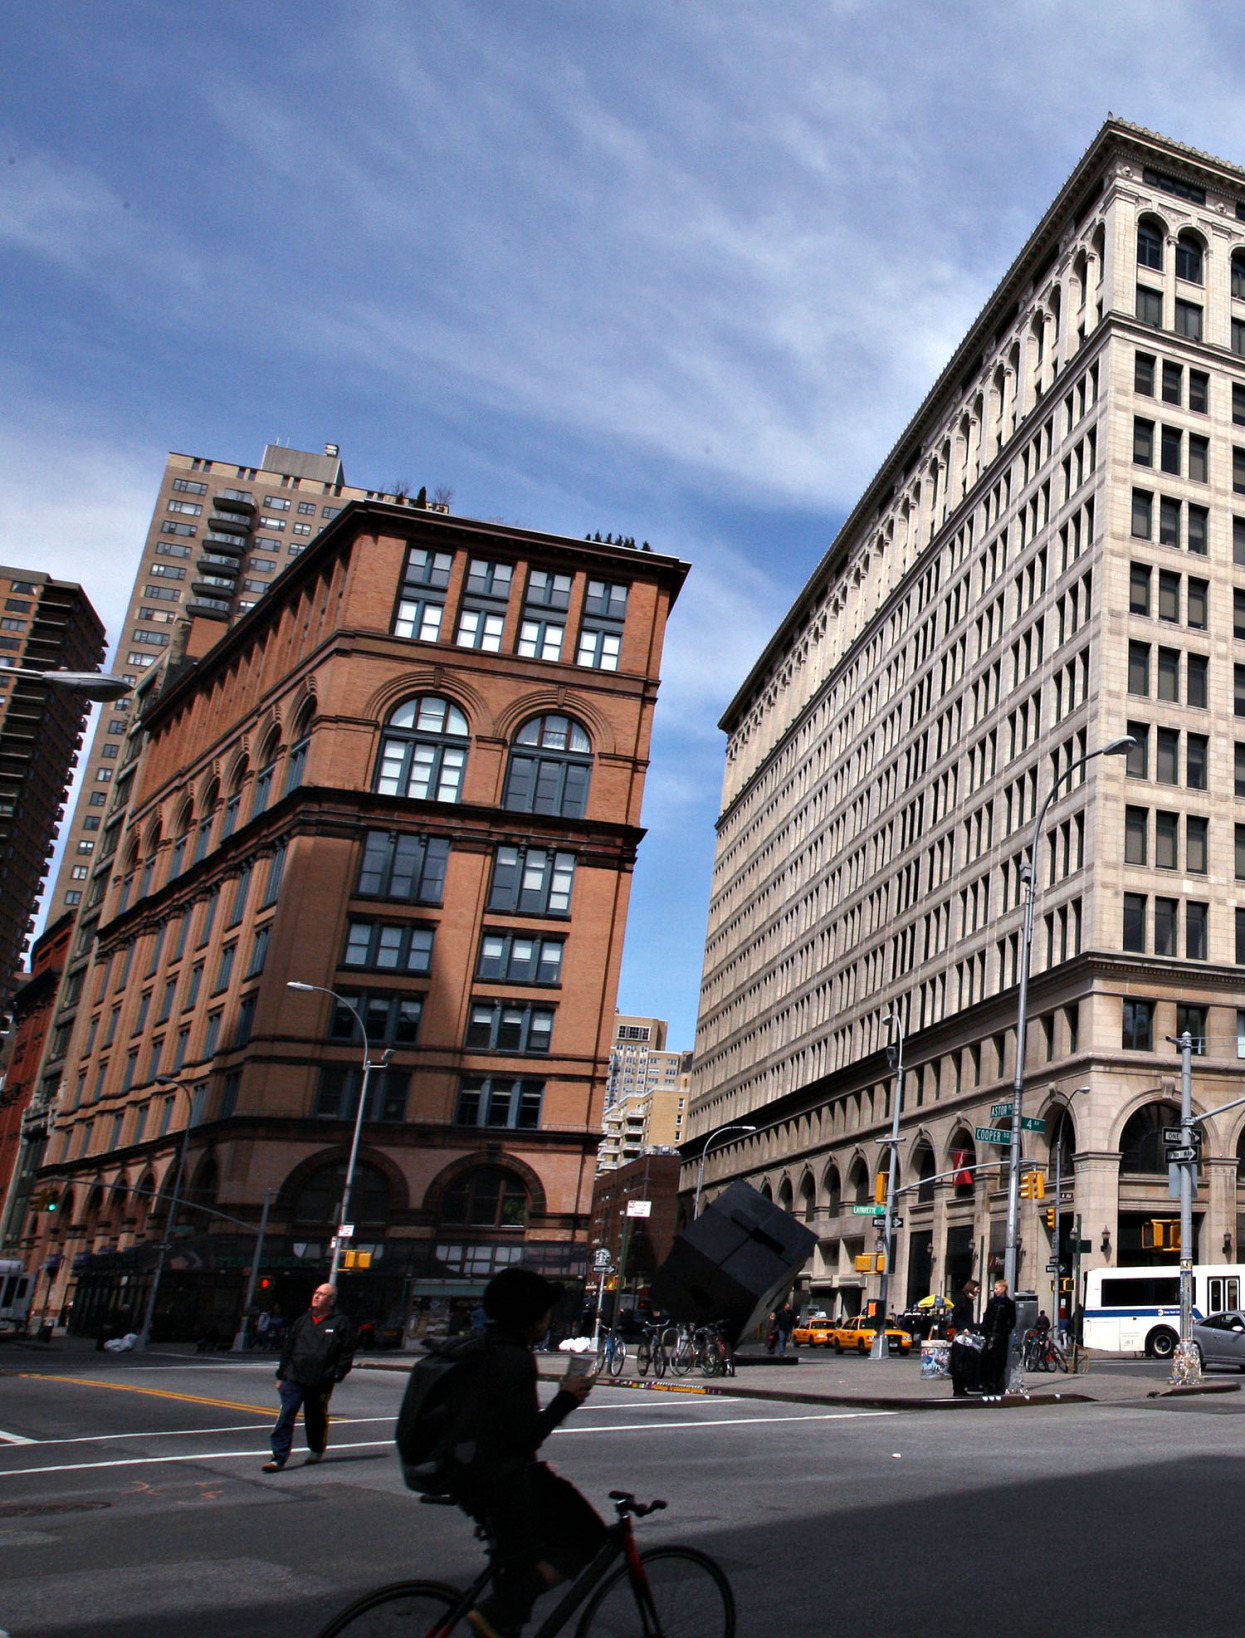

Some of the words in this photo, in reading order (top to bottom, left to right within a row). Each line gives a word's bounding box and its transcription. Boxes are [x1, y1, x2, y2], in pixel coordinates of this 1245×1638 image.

[991, 1105, 1007, 1116] ASTOR
[1026, 1119, 1032, 1130] 4
[976, 1129, 1001, 1142] COOPER
